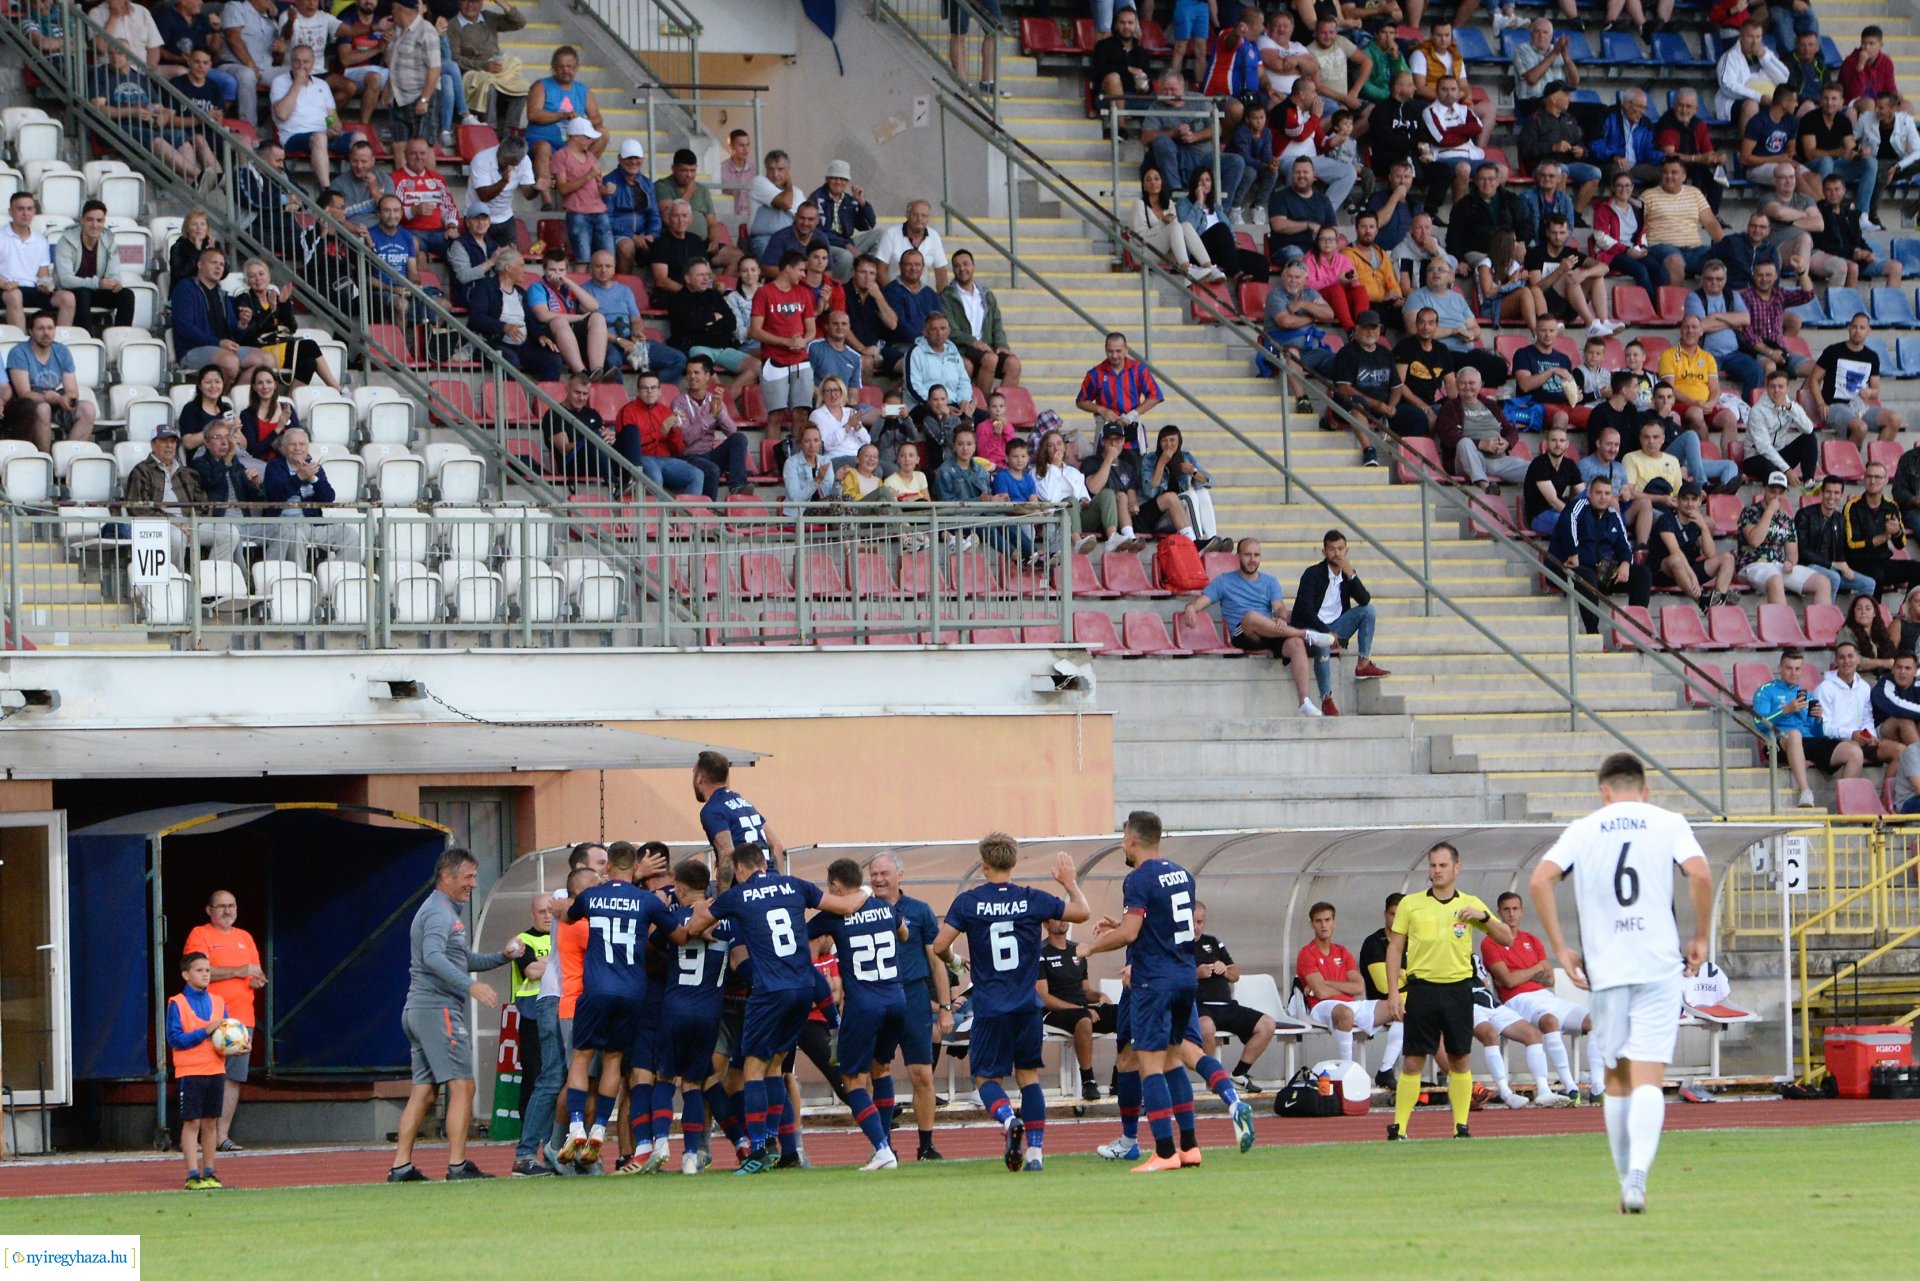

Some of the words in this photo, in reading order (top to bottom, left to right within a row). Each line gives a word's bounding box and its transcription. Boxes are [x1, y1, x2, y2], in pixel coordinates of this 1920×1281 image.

[139, 530, 163, 539] SZEKTOR
[137, 549, 166, 576] VIP
[1600, 817, 1647, 832] KATONA
[1614, 841, 1640, 907] 6
[742, 884, 778, 902] PAPP
[778, 882, 796, 896] M.
[589, 897, 640, 912] KALOCSAI
[843, 906, 893, 926] SHVEDYUK
[976, 899, 1028, 916] FARKAS
[1170, 891, 1195, 944] 5
[1614, 917, 1645, 934] PMFC
[589, 916, 637, 965] 74
[766, 907, 797, 957] 8
[849, 930, 898, 981] 22
[990, 920, 1020, 971] 6
